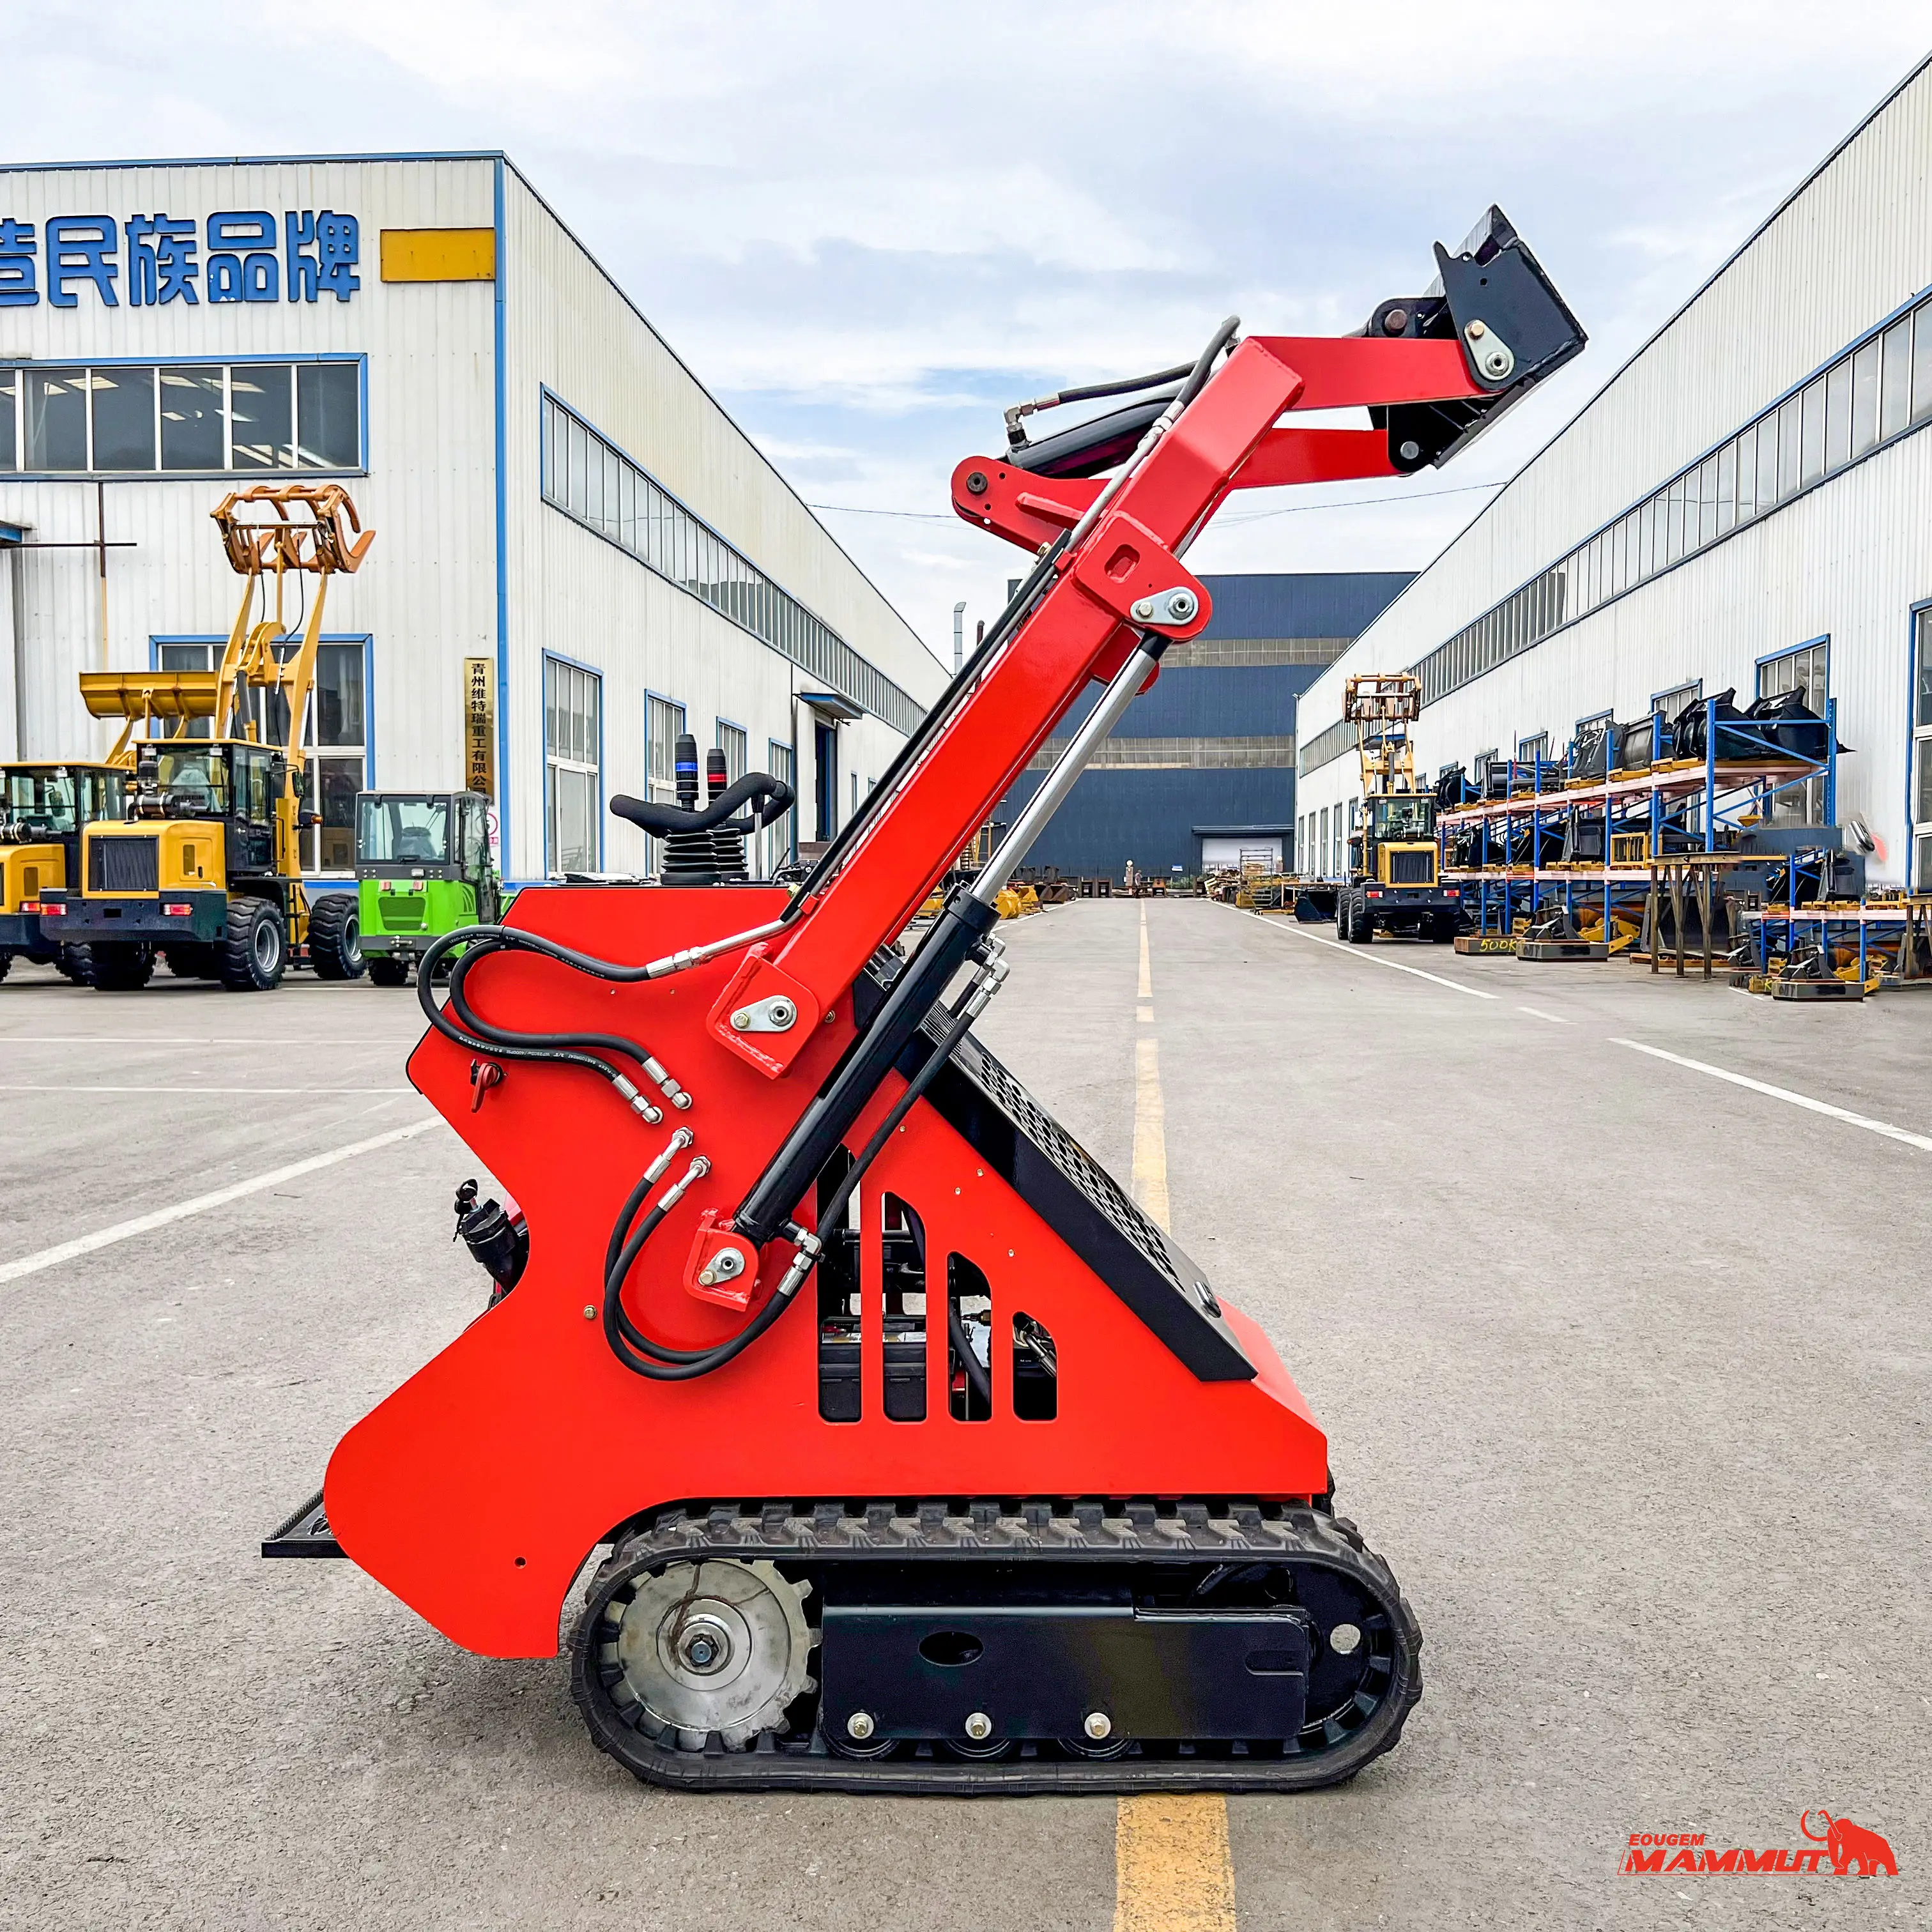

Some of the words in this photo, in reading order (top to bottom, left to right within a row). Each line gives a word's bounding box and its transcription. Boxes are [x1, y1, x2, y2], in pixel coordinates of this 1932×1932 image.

[0, 210, 360, 307] 造民族品牌
[1480, 939, 1526, 953] 500K
